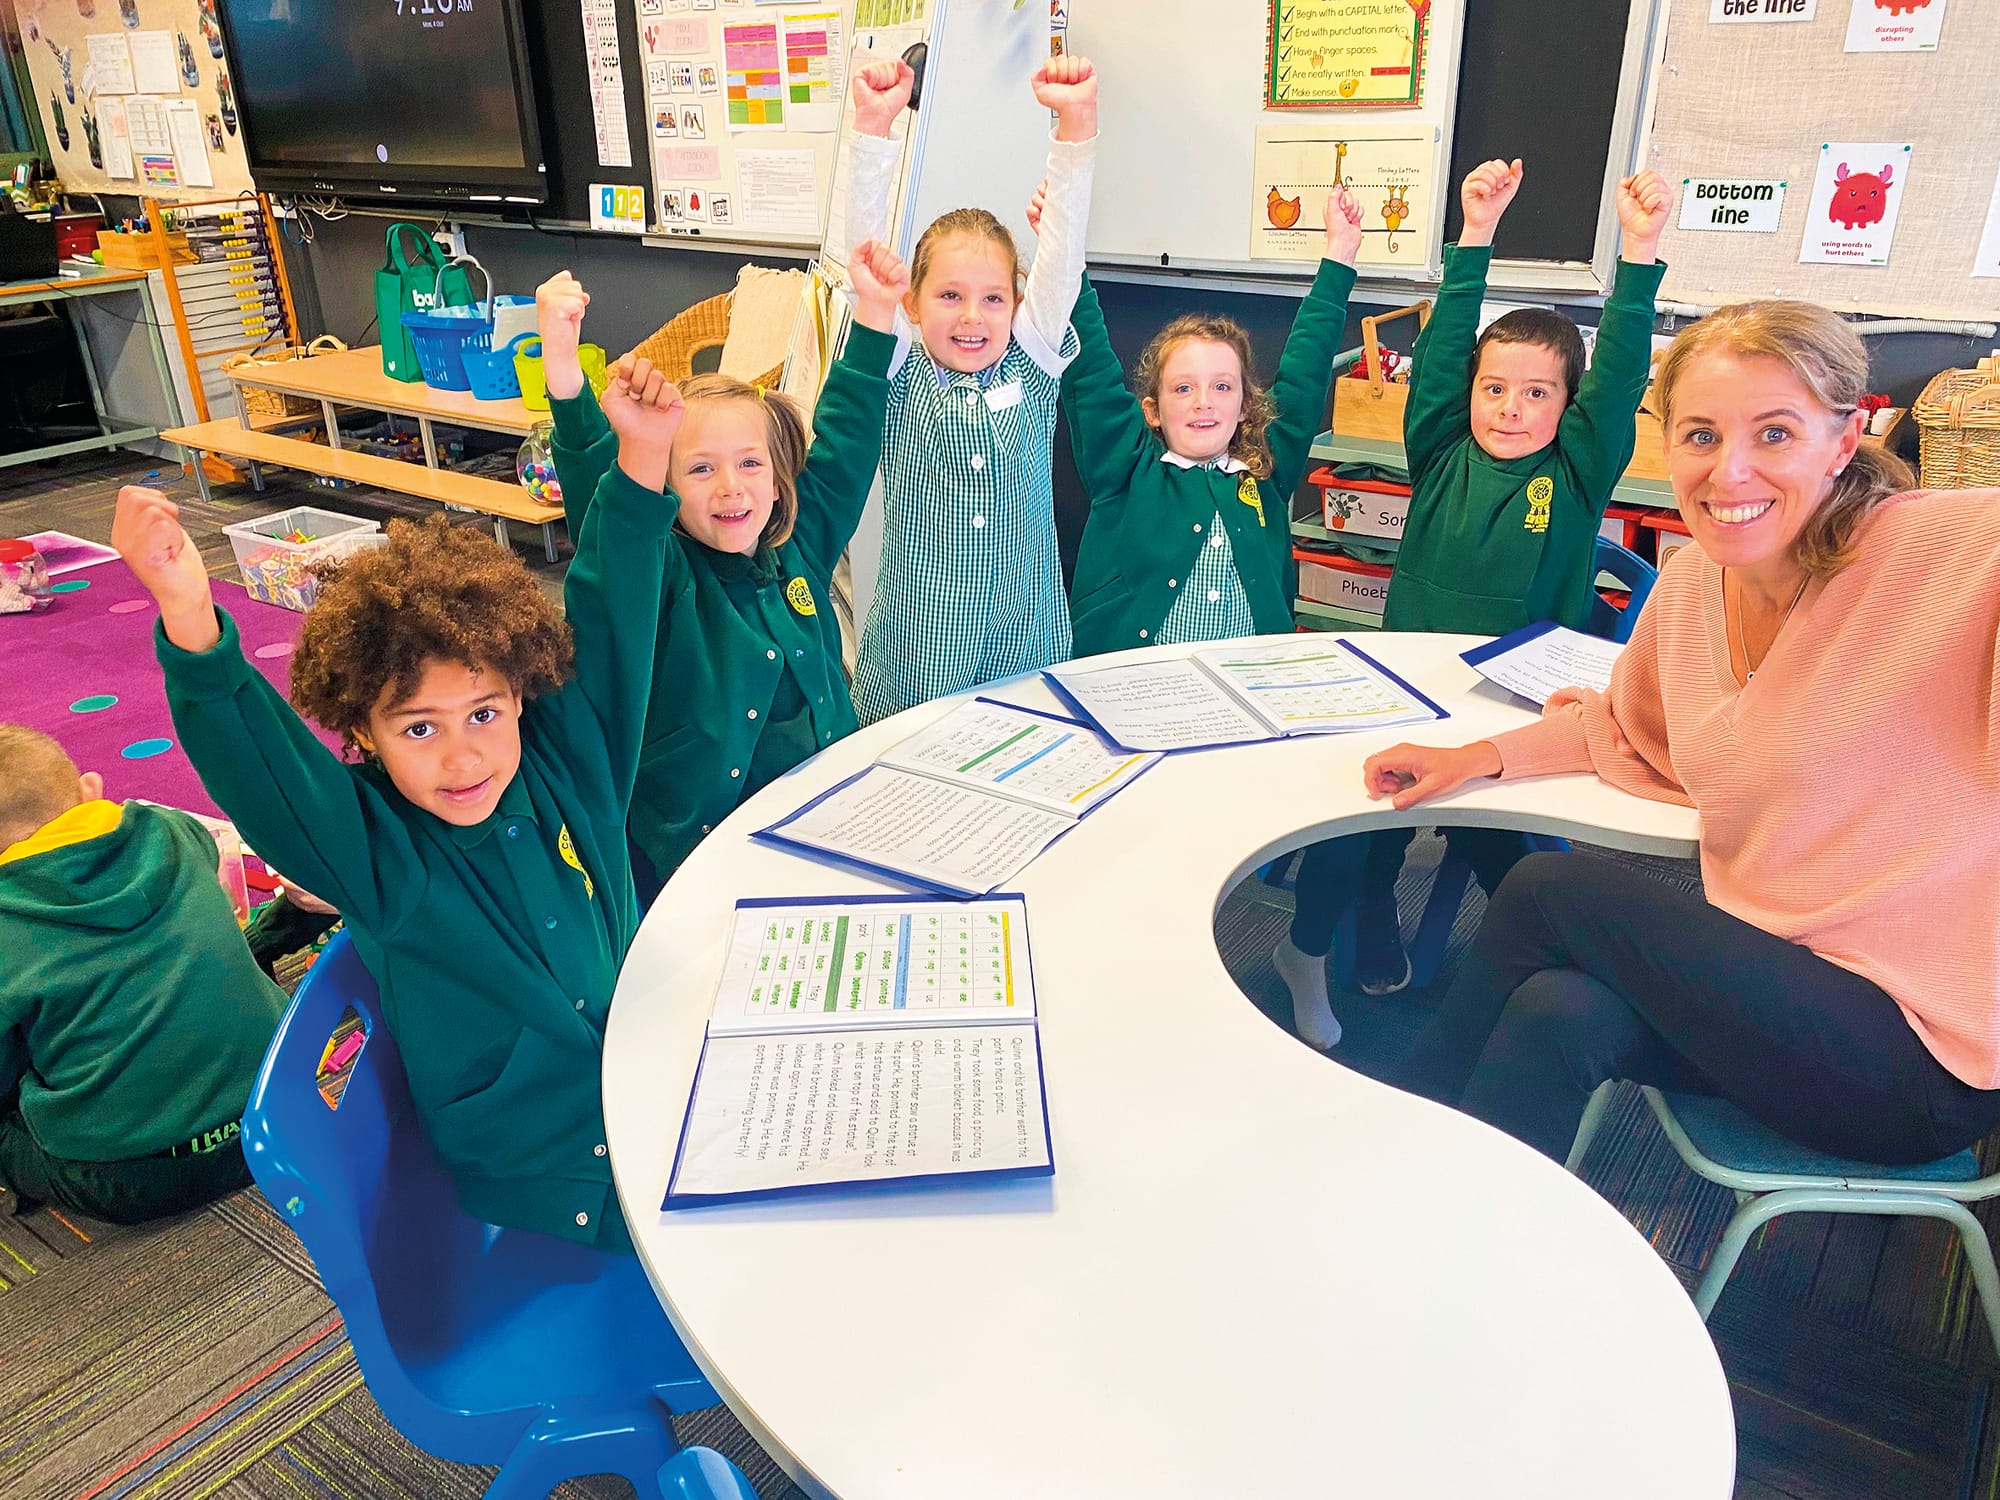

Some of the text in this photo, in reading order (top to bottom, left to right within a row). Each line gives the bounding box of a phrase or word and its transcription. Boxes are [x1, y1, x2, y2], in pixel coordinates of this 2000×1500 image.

[1296, 9, 1317, 20] Begin
[1318, 8, 1336, 18] with
[1338, 9, 1344, 17] a
[1345, 5, 1381, 17] CAPITAL
[1723, 0, 1806, 16] the line
[1295, 28, 1310, 37] End
[1311, 27, 1328, 37] with
[1329, 26, 1377, 38] punctuation
[1875, 25, 1914, 34] disrupting
[1293, 47, 1312, 56] Have
[1319, 46, 1343, 57] finger
[672, 75, 692, 86] STEM
[1291, 68, 1365, 80] Are neatly written.
[1291, 88, 1338, 97] Make sense.
[1696, 183, 1773, 201] Bottom
[1711, 205, 1750, 225] line
[1821, 241, 1840, 249] using
[1841, 241, 1863, 249] words
[1825, 249, 1843, 257] hurt
[802, 919, 816, 945] because
[846, 923, 869, 1009] park Quinn butterfly
[877, 923, 896, 1005] look statue pointed
[770, 983, 784, 1006] where
[806, 985, 822, 1002] they
[813, 1042, 826, 1061] what
[855, 1041, 867, 1060] what
[873, 1040, 886, 1054] the
[893, 1040, 905, 1054] the
[952, 1038, 964, 1052] and
[968, 1037, 983, 1058] They
[990, 1037, 1005, 1055] park
[1010, 1036, 1023, 1060] Quinn
[752, 1044, 766, 1074] spotted
[772, 1043, 788, 1074] brother
[993, 1056, 1003, 1066] to
[811, 1063, 824, 1075] his
[852, 1070, 863, 1081] on
[872, 1055, 884, 1082] statue
[952, 1060, 962, 1082] warm
[971, 1059, 984, 1078] took
[992, 1067, 1005, 1084] have
[1013, 1061, 1024, 1075] and
[769, 1075, 779, 1090] was
[848, 1081, 862, 1095] top
[891, 1076, 904, 1089] He
[910, 1069, 922, 1100] brother
[972, 1078, 982, 1098] some
[1014, 1075, 1025, 1087] his
[741, 1081, 760, 1115] stunning
[807, 1076, 822, 1108] brother
[870, 1082, 883, 1098] and
[952, 1082, 965, 1110] blanket
[777, 1043, 807, 1157] looked again to see where his
[819, 1041, 845, 1160] Quinn looked and looked to see
[849, 1096, 863, 1106] of
[867, 1098, 881, 1115] said
[888, 1089, 902, 1119] pointed
[1015, 1087, 1027, 1117] brother
[848, 1107, 862, 1122] the
[907, 1101, 919, 1116] saw
[804, 1109, 818, 1125] had
[867, 1116, 880, 1126] to
[888, 1120, 899, 1130] to
[760, 1127, 774, 1140] He
[952, 1111, 964, 1141] because
[1016, 1118, 1027, 1136] went
[864, 1126, 879, 1149] Quinn
[887, 1130, 900, 1144] the
[905, 1123, 919, 1148] statue
[969, 1125, 984, 1146] picnic
[756, 1141, 771, 1160] then
[882, 1144, 898, 1158] top
[951, 1149, 961, 1162] was
[968, 1146, 981, 1159] rug
[1016, 1146, 1030, 1159] the
[795, 1159, 809, 1172] He
